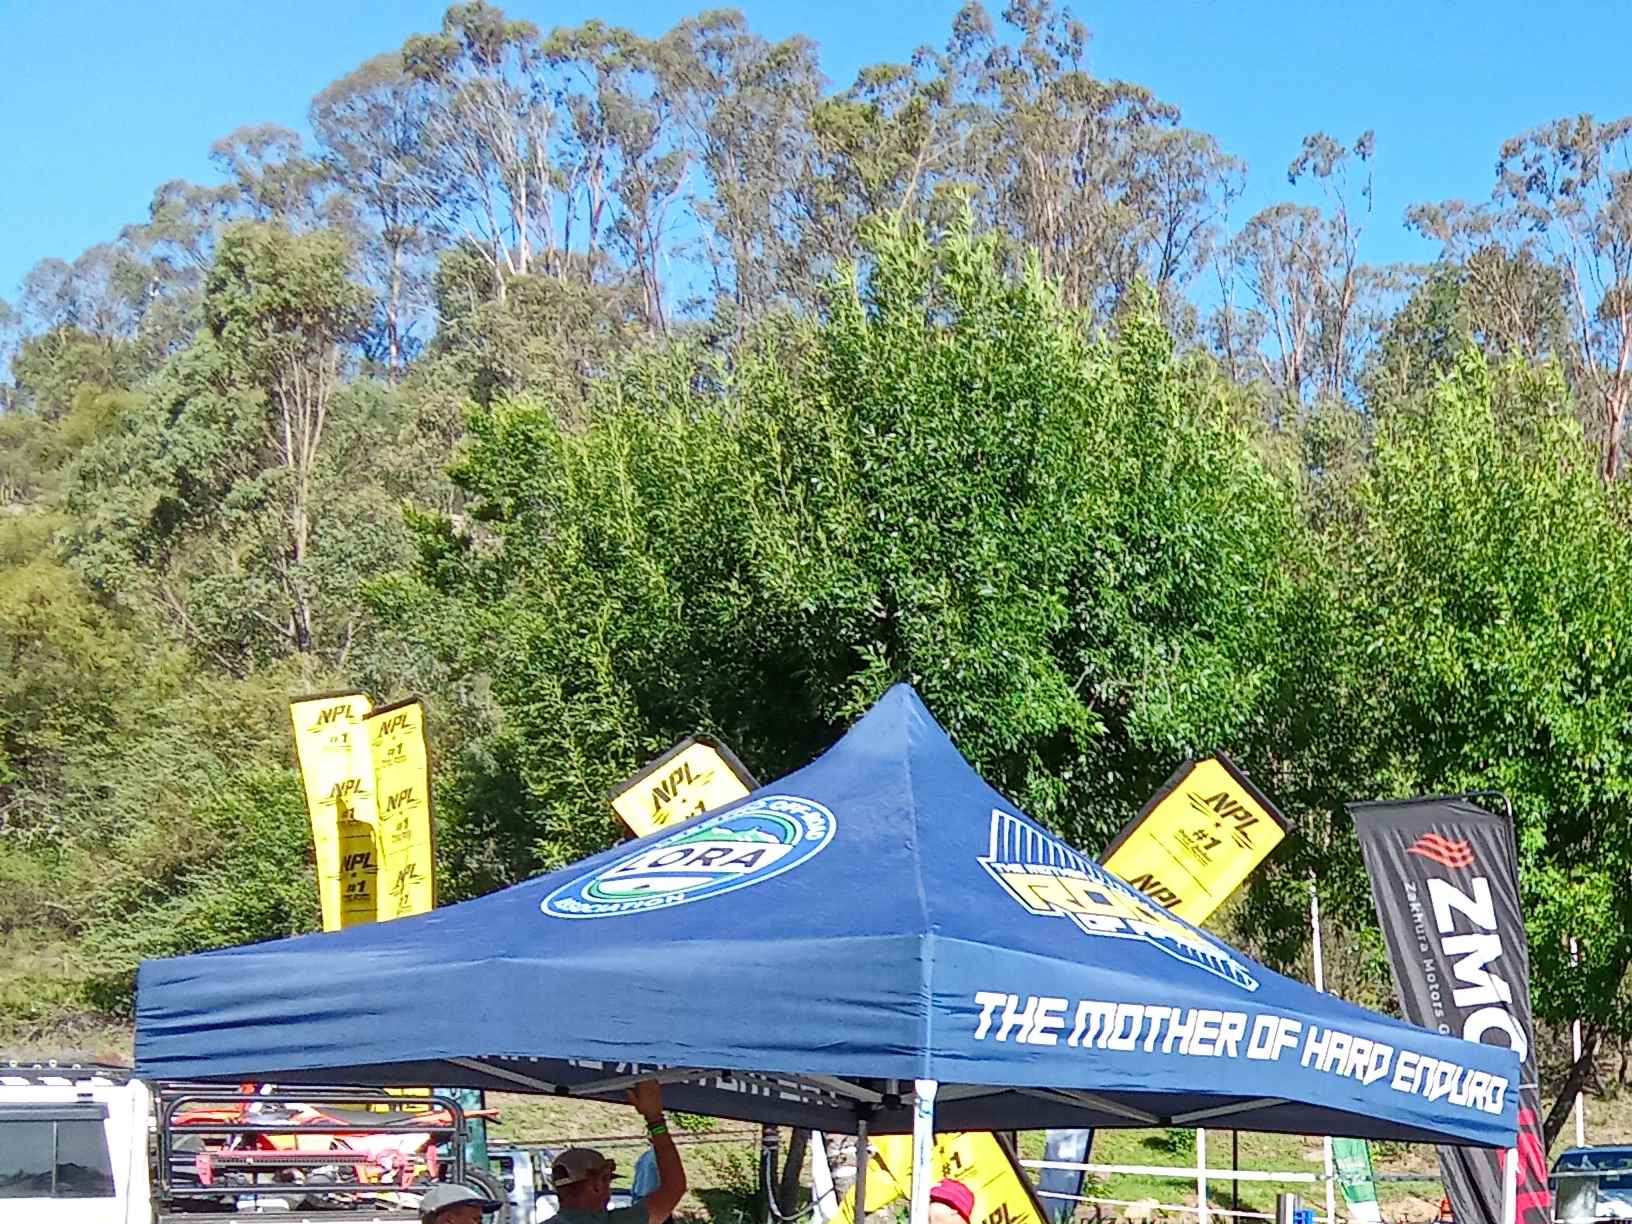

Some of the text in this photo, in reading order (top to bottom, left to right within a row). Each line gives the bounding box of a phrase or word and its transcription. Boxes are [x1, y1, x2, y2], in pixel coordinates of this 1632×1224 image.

[317, 704, 354, 726] NPL
[378, 712, 411, 738] NPL
[330, 779, 368, 798] NPL
[386, 787, 416, 812] NPL
[650, 762, 704, 812] NPL
[1205, 792, 1259, 843] NPL
[1193, 830, 1222, 850] #1
[1403, 881, 1428, 953] Zakhura
[1424, 958, 1445, 1018] Motors
[974, 991, 1509, 1116] THE MOTHER OF HARD ENDURO
[942, 1151, 963, 1177] #1
